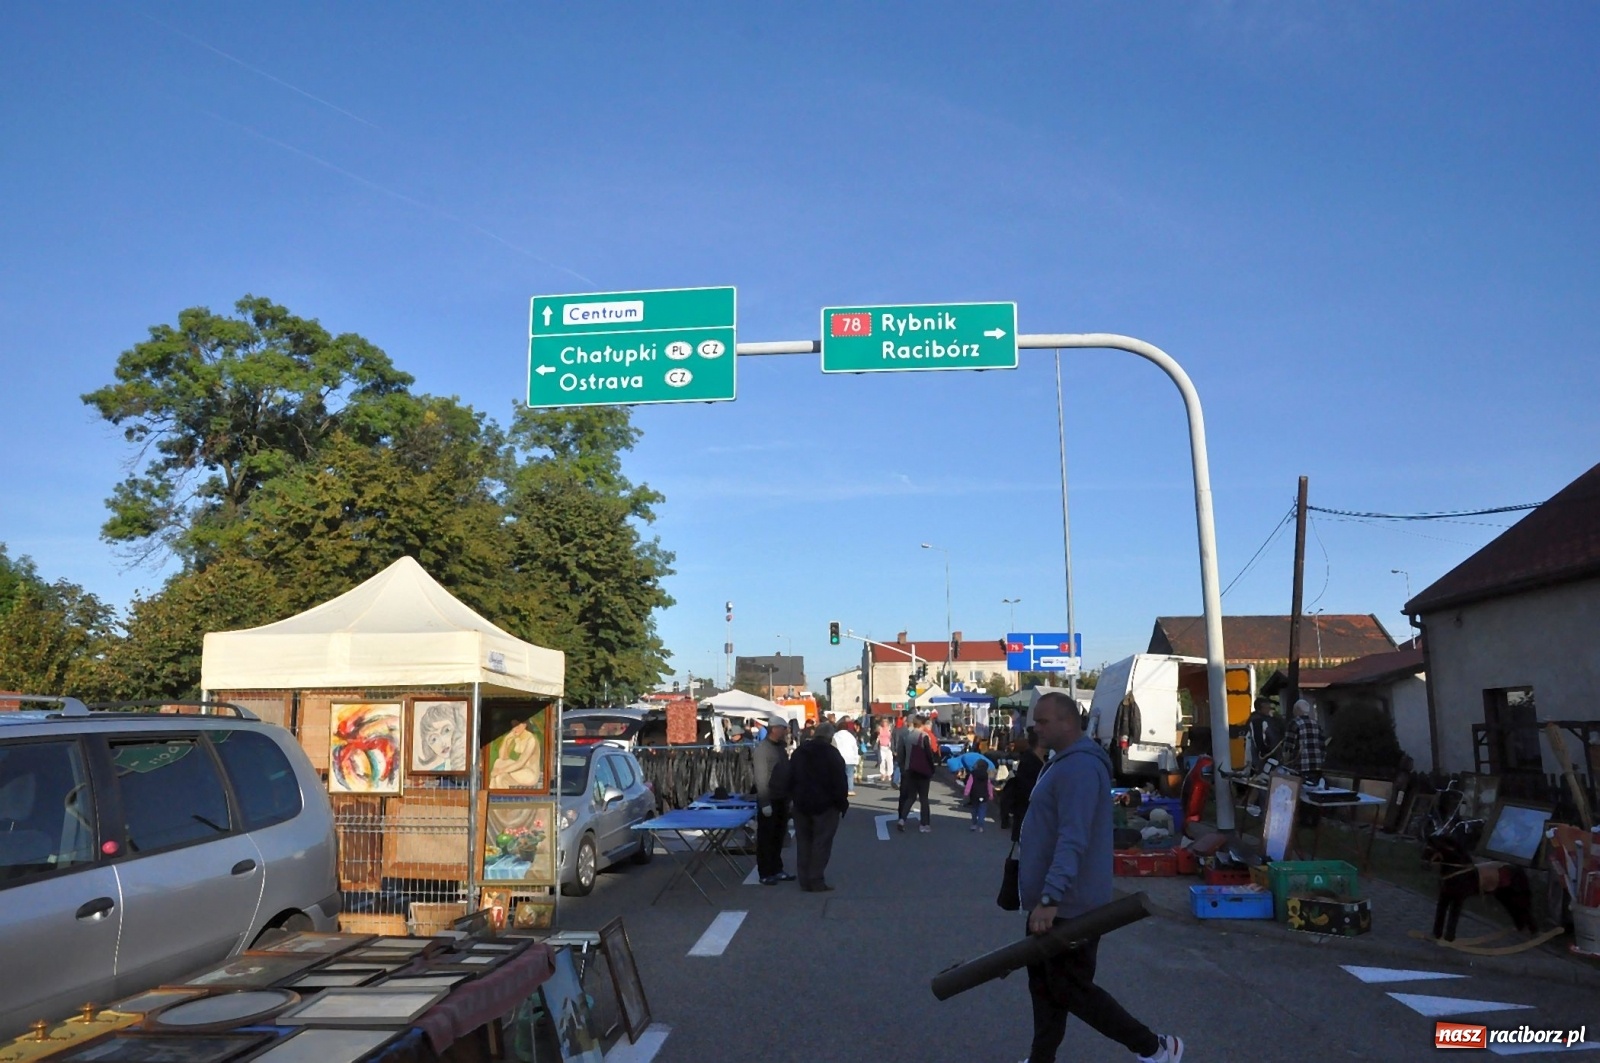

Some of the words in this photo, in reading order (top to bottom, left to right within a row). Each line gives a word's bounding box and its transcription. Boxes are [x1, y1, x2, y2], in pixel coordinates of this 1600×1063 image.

[569, 306, 638, 321] Centrum
[842, 317, 862, 332] 78
[881, 312, 957, 337] Rybnik
[560, 343, 657, 367] Chałupki
[672, 345, 685, 356] PL
[702, 344, 718, 355] CZ
[882, 339, 980, 359] Racibórz
[559, 373, 643, 391] Ostrava
[669, 372, 686, 383] CZ
